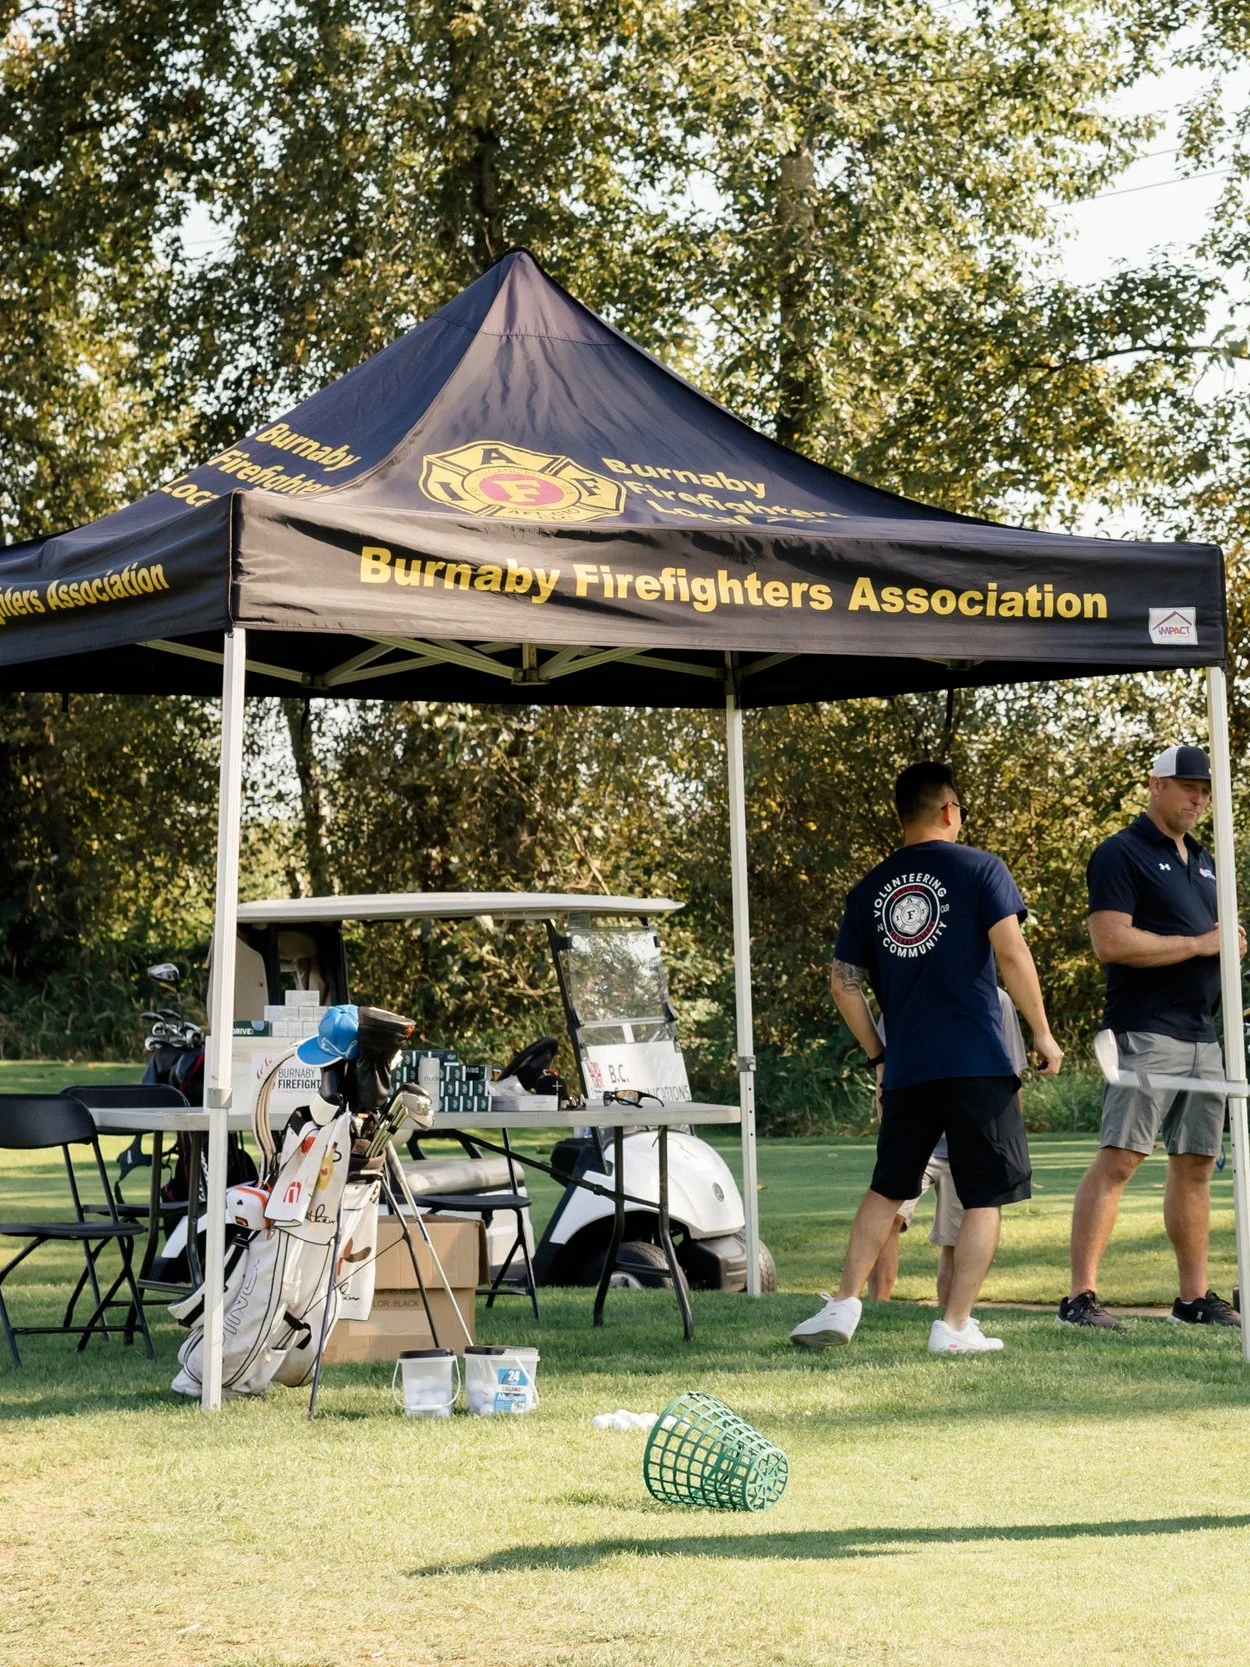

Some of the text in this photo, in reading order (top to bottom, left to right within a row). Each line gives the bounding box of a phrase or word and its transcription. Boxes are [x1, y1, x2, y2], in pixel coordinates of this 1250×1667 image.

[255, 423, 361, 472] Burnaby
[206, 449, 335, 496] Firefighter
[601, 457, 766, 499] Burnaby
[159, 475, 221, 508] Loc
[646, 499, 753, 526] Local
[46, 561, 169, 610] Association
[359, 546, 1109, 619] Burnaby Firefighters Association
[873, 872, 948, 918] VOLUNTEERING
[882, 921, 948, 959] COMMUNITY
[277, 1079, 321, 1090] FIREFIGHT
[278, 1067, 316, 1079] BURNABY
[608, 1064, 630, 1084] B.C.
[393, 1300, 420, 1308] BLACK
[507, 1370, 520, 1382] 24
